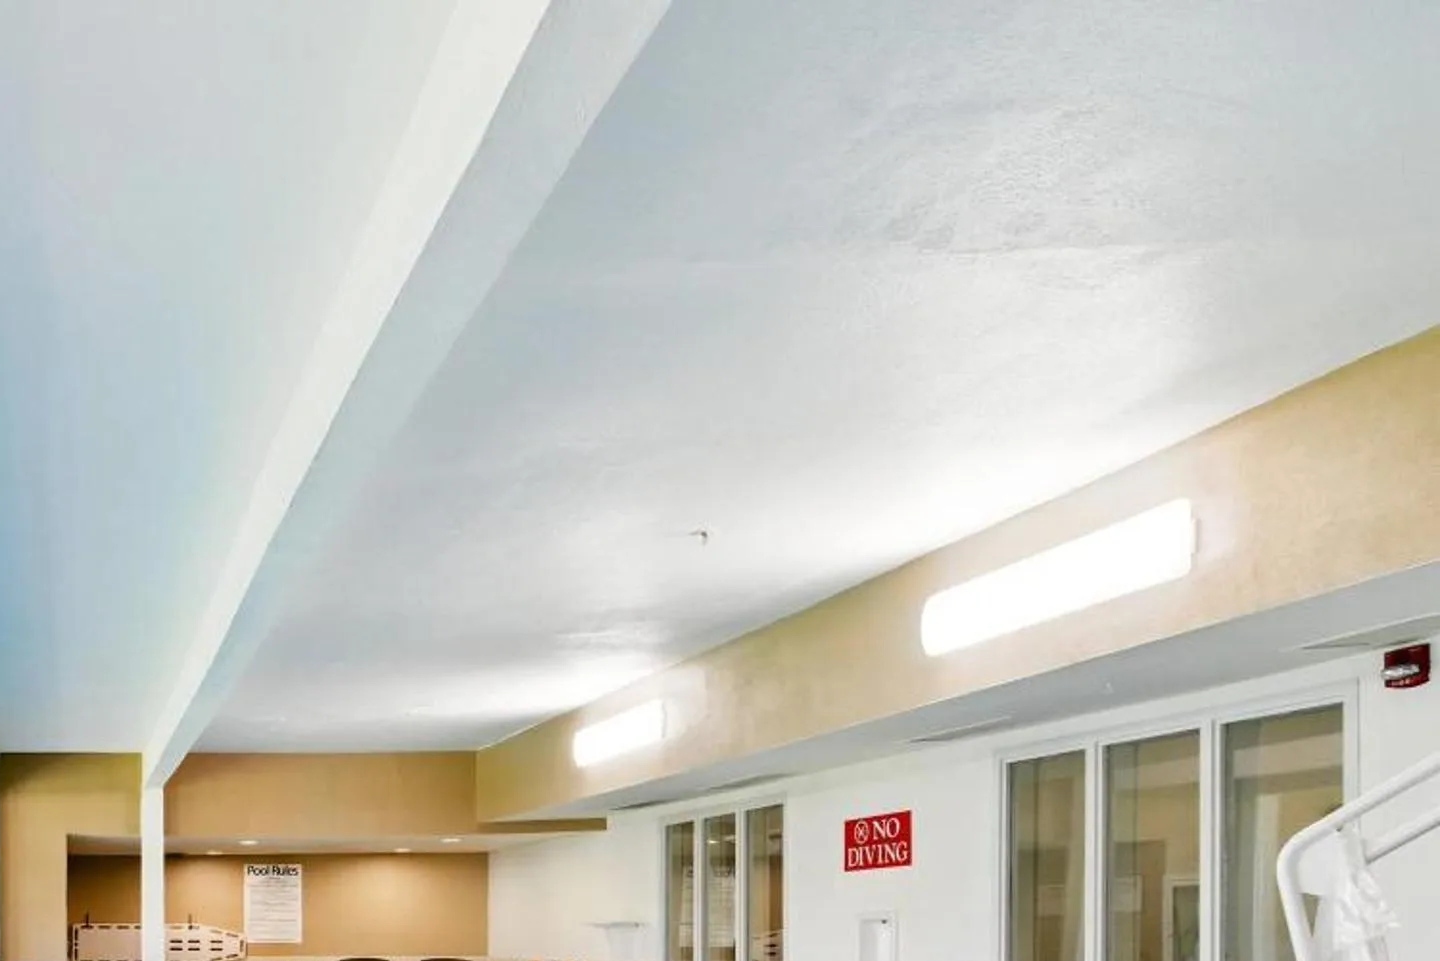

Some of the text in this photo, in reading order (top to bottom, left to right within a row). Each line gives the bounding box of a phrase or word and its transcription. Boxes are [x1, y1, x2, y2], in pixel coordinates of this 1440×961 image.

[872, 817, 900, 840] NO
[847, 840, 909, 867] DIVING
[247, 865, 299, 876] Pool Rules
